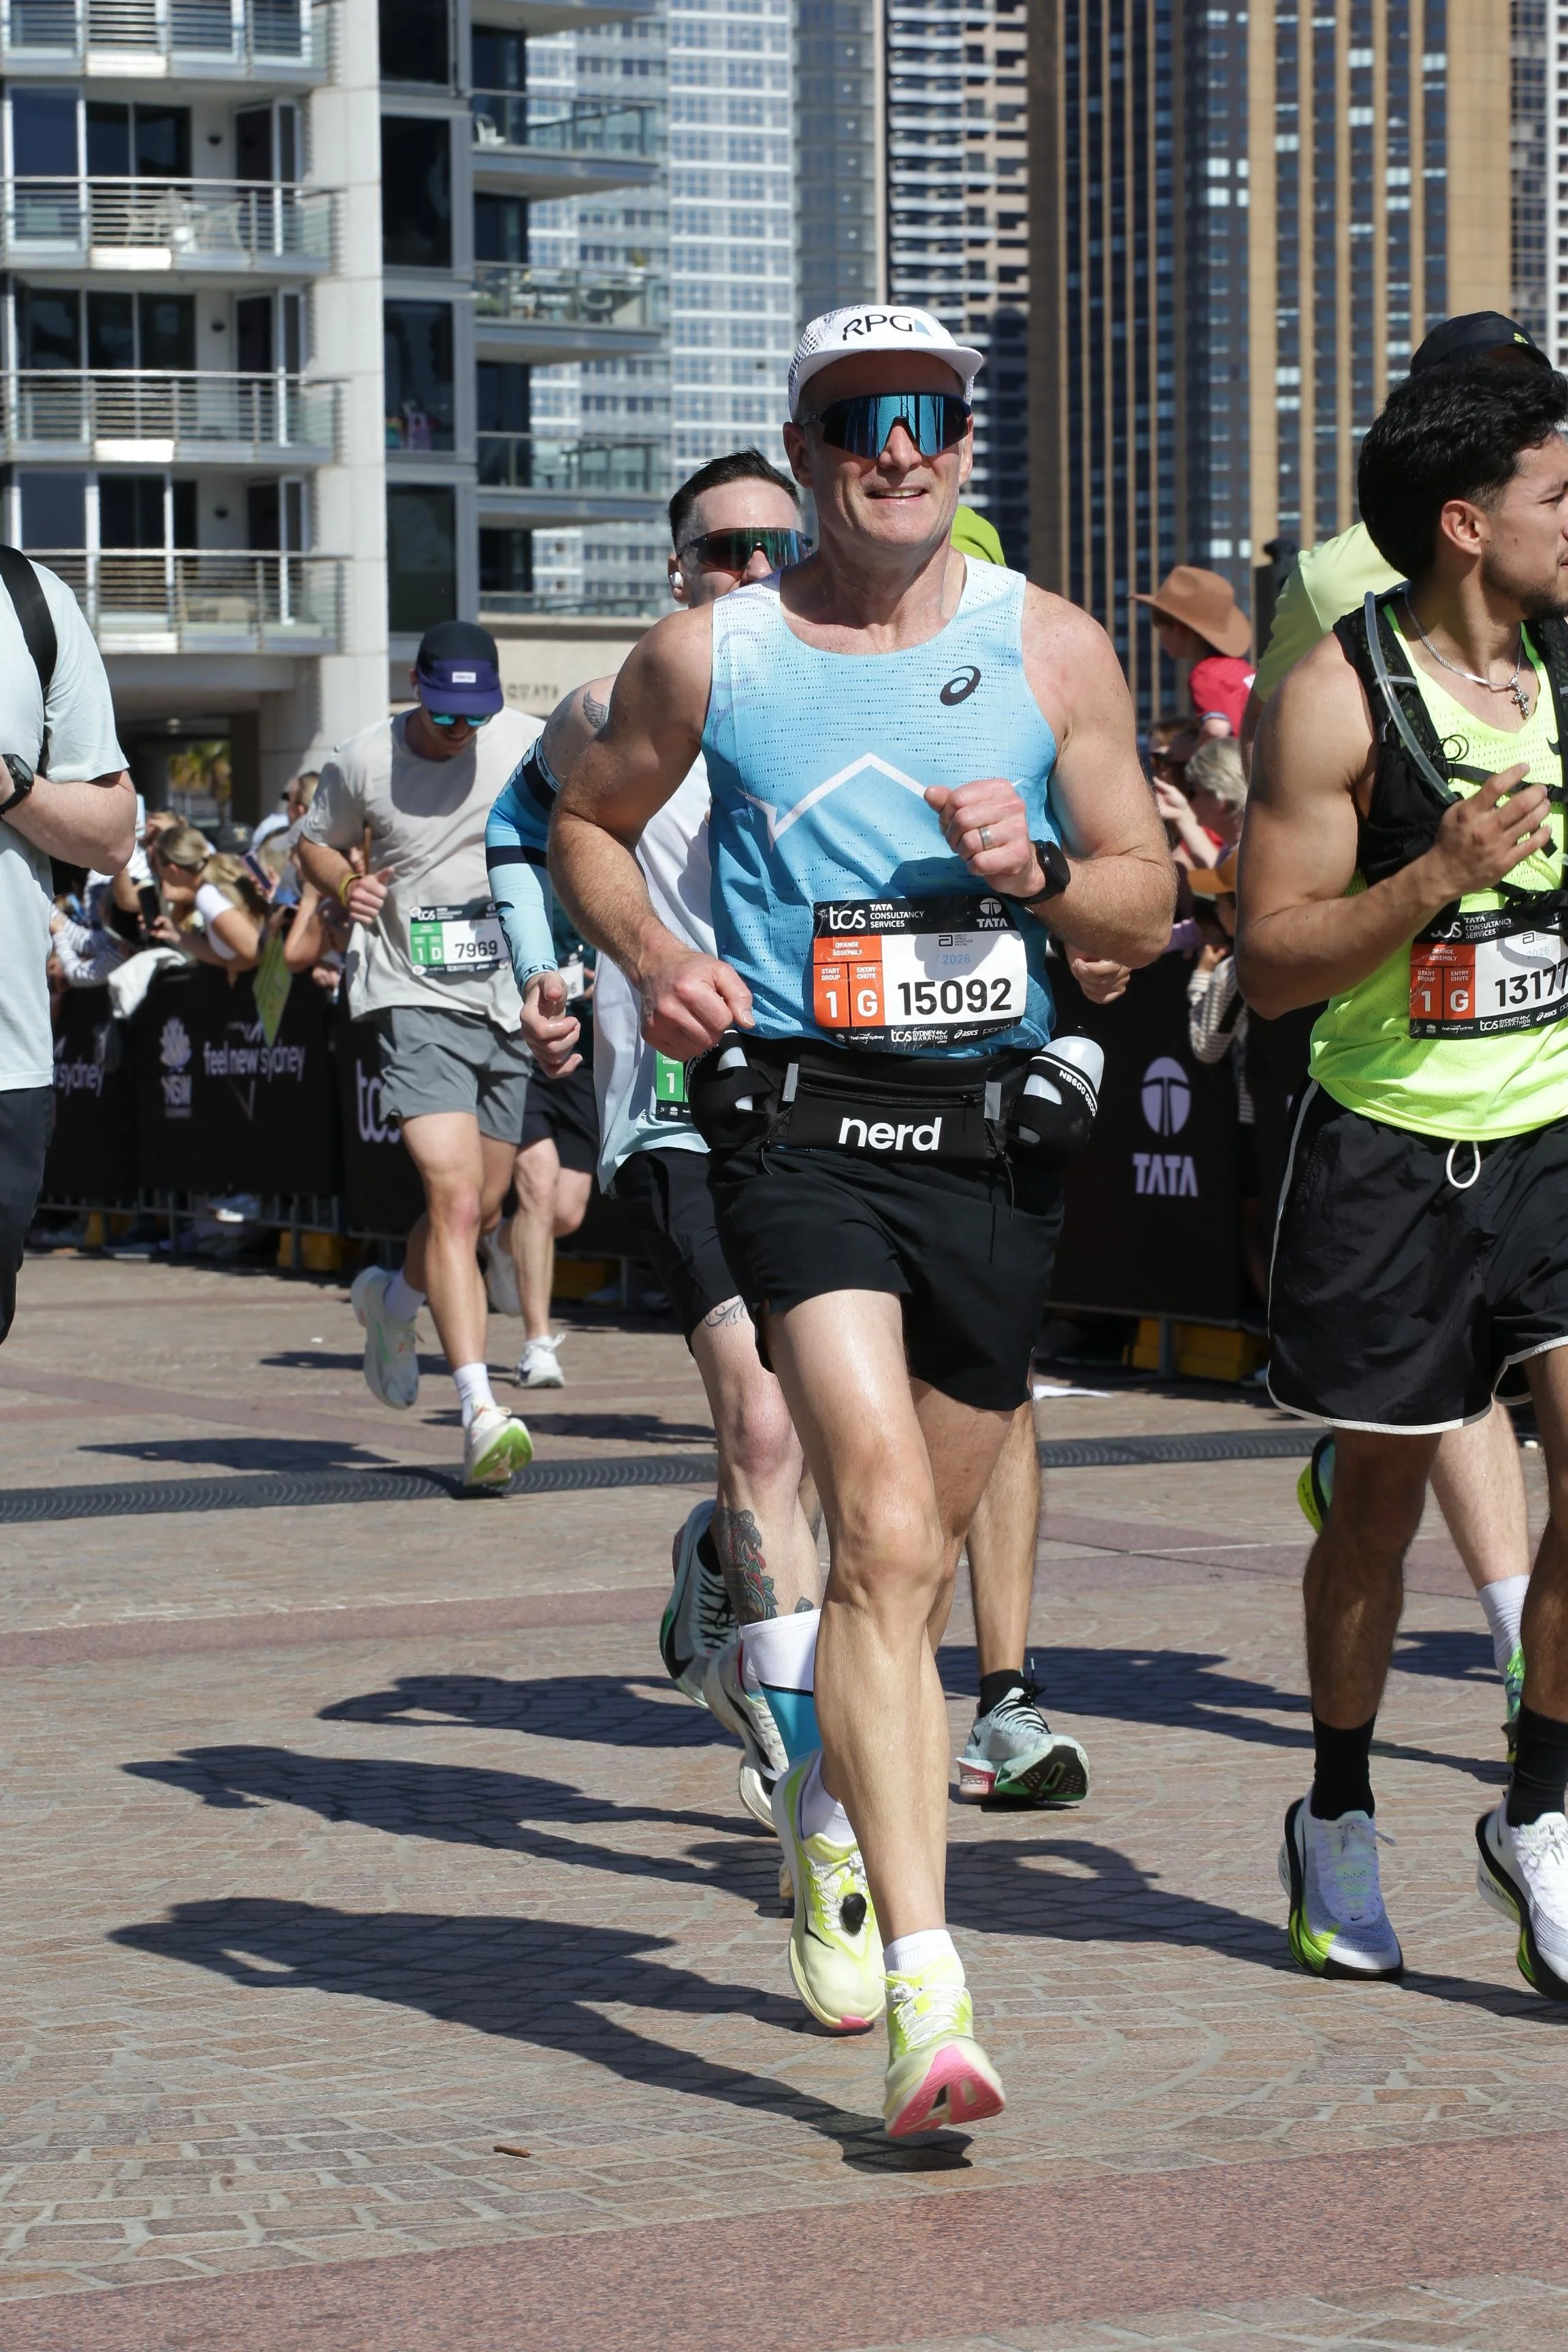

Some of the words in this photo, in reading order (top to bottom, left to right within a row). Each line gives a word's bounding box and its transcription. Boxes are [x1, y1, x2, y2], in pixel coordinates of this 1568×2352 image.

[843, 314, 913, 341] RPG
[829, 906, 866, 930] tcs
[870, 911, 924, 919] CONSULTANCY
[870, 920, 905, 928] SERVICES
[977, 918, 1008, 928] TATA
[1465, 918, 1512, 931] CONSULTANCY
[1466, 929, 1496, 938] SERVICES
[455, 941, 498, 958] 7969
[942, 954, 970, 964] 2026
[826, 991, 838, 1018] 1
[857, 990, 878, 1018] G
[898, 978, 1012, 1015] 15092
[1421, 990, 1431, 1012] 1
[1450, 990, 1469, 1012] G
[1544, 1009, 1557, 1019] asics
[891, 1029, 912, 1042] tcs
[962, 1029, 979, 1037] asics
[1480, 1020, 1499, 1031] tcs
[203, 1041, 229, 1076] feel
[259, 1039, 305, 1083] sydney
[666, 1073, 674, 1094] 1
[1059, 1069, 1085, 1095] NB600
[356, 1058, 402, 1144] tc
[838, 1117, 943, 1152] nerd
[1132, 1153, 1198, 1198] TATA
